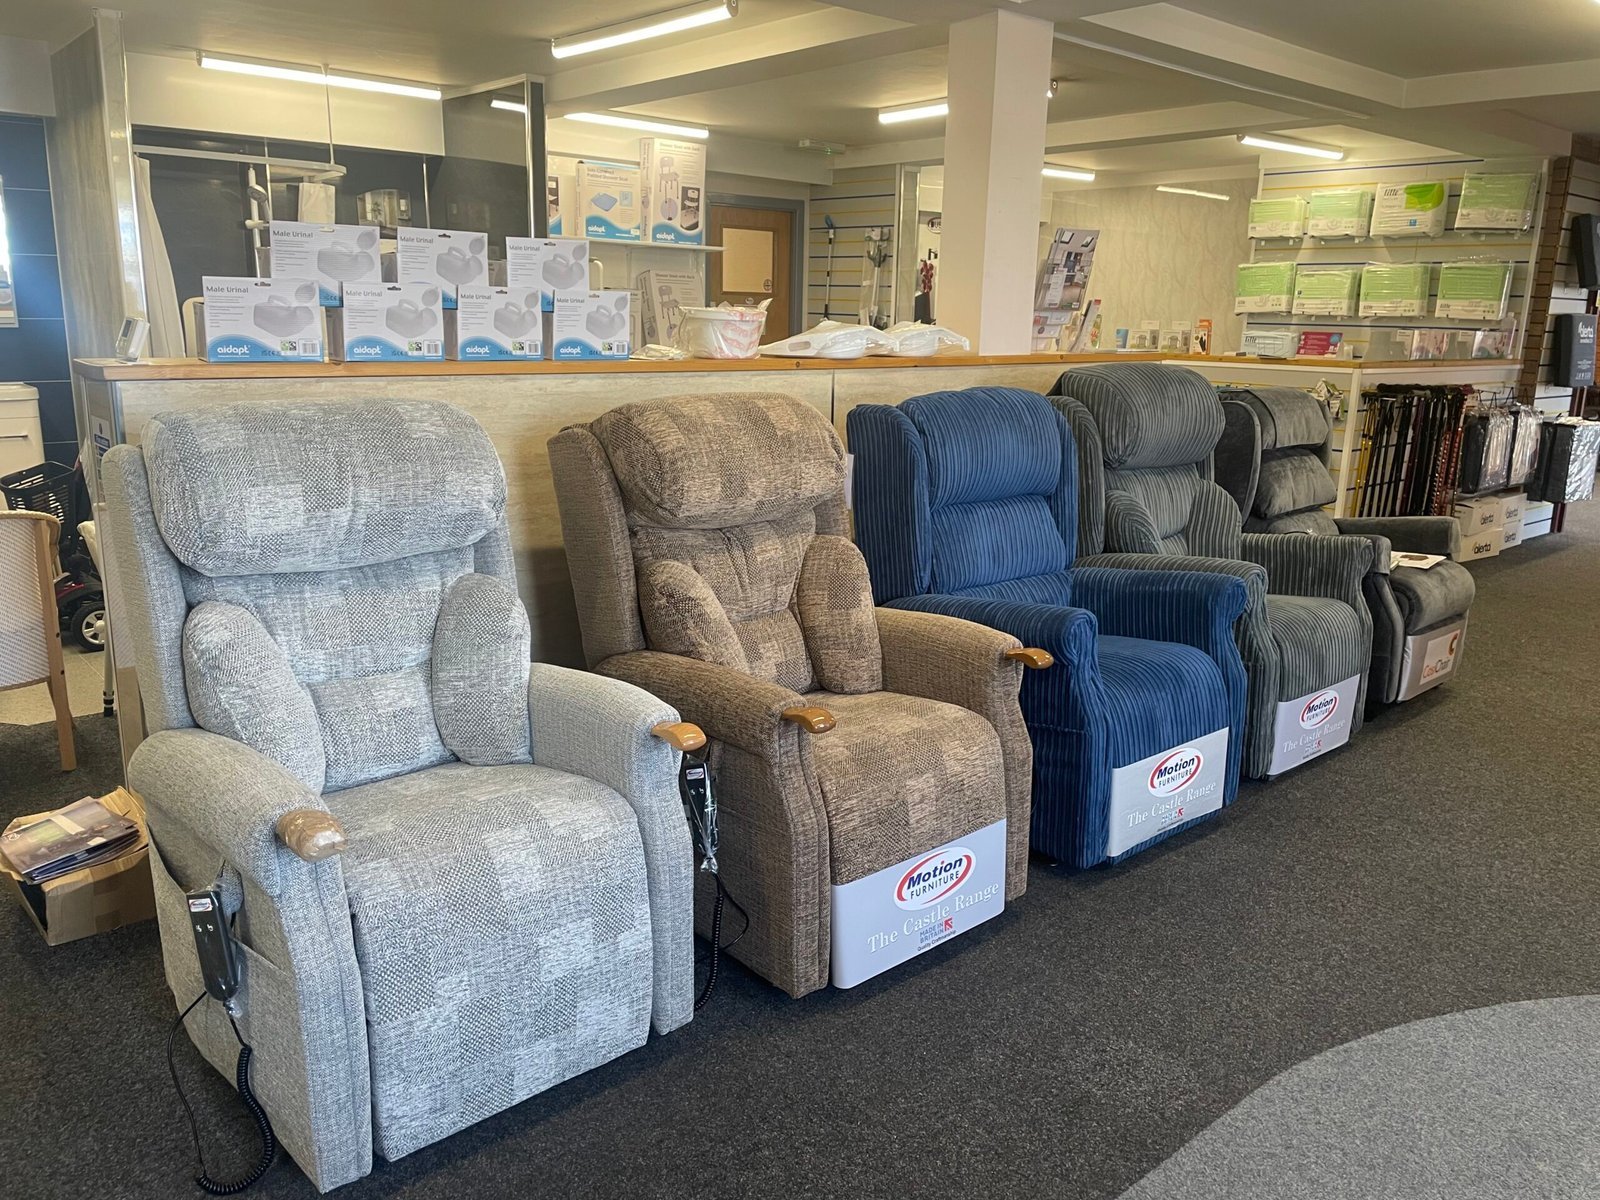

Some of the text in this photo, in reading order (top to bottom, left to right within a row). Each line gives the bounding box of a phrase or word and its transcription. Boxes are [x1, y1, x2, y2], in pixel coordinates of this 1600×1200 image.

[272, 230, 290, 238] Male
[217, 344, 248, 355] aidapt
[354, 345, 380, 355] aidapt
[466, 344, 490, 354] aidapt
[560, 345, 581, 354] aidapt
[1306, 698, 1333, 715] Motion
[1306, 707, 1331, 720] FURNITURE
[1283, 740, 1298, 752] The
[1300, 729, 1322, 745] Castle
[1324, 720, 1346, 735] Range
[1157, 757, 1195, 780] Motion
[1158, 768, 1192, 788] FURNITURE
[1127, 810, 1148, 827] The
[1152, 796, 1183, 816] Castle
[1186, 782, 1216, 802] Range
[906, 856, 962, 890] Motion
[910, 870, 960, 900] FURNITURE
[867, 882, 999, 953] The Castle Range
[920, 921, 944, 937] MADE IN
[920, 928, 944, 944] BRITAIN
